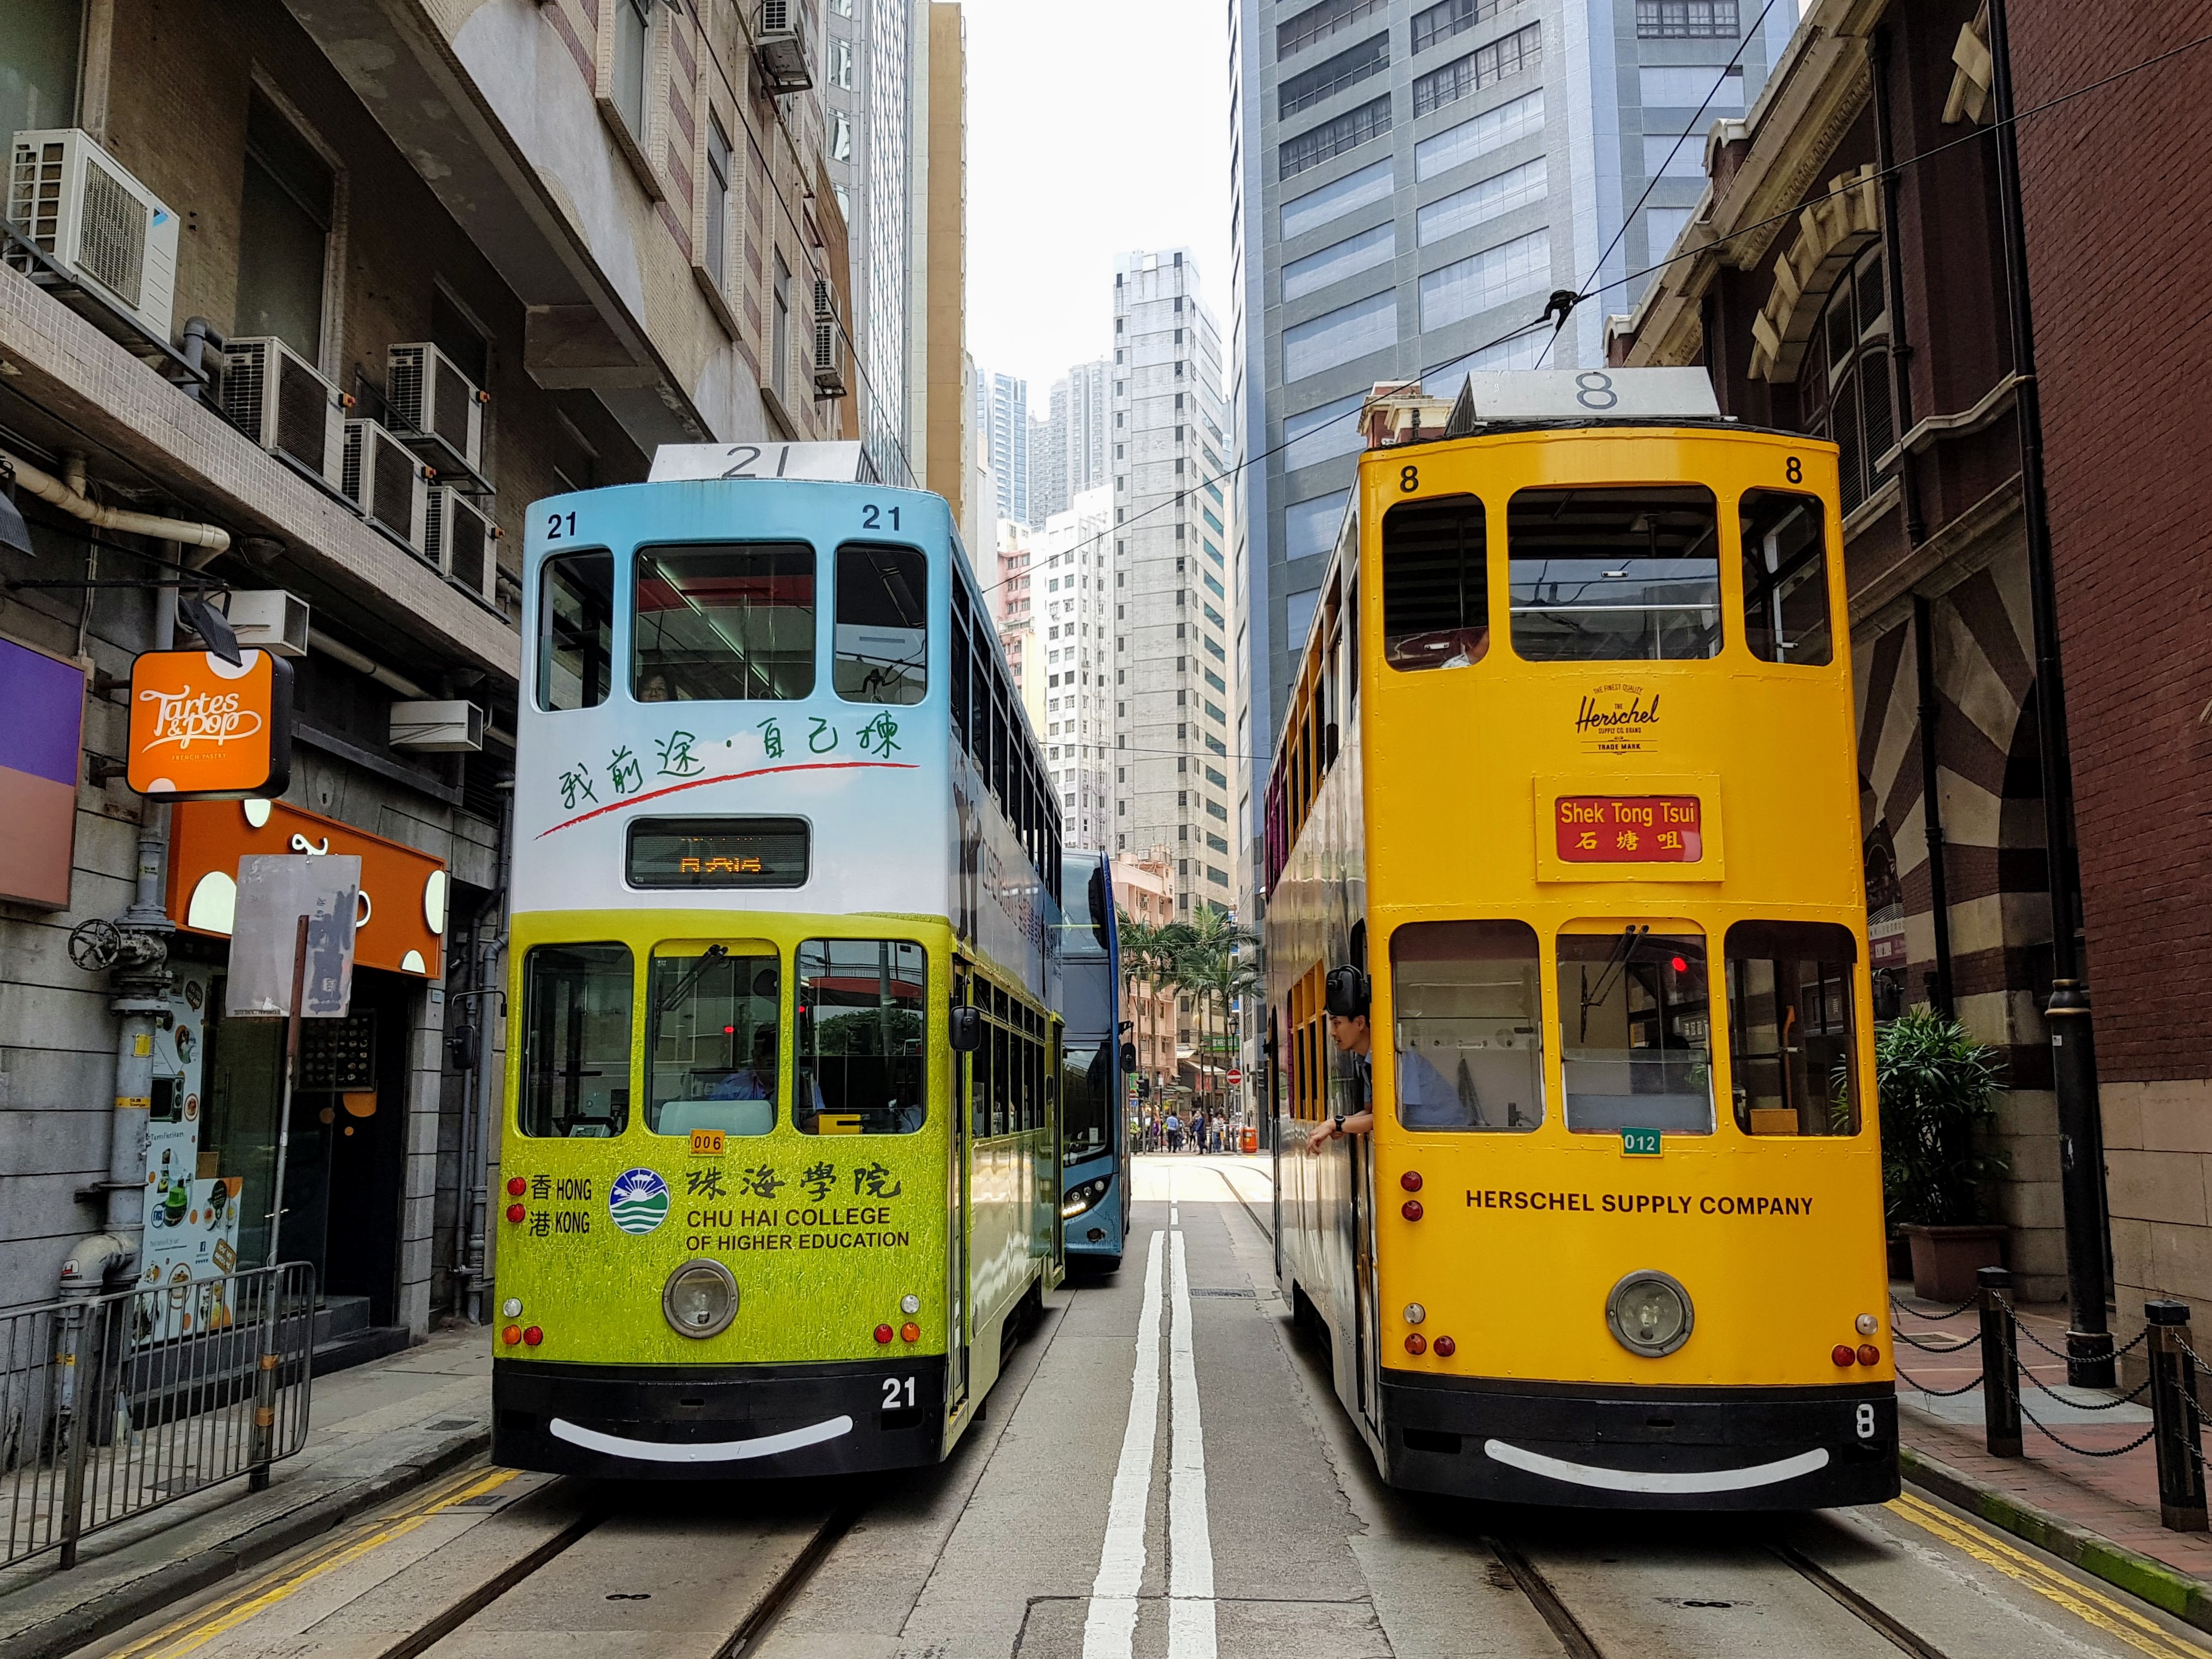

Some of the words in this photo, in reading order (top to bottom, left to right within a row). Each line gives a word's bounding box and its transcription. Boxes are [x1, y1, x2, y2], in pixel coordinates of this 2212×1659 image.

[1575, 372, 1618, 409] 8
[721, 445, 790, 478] 21
[1786, 456, 1803, 484] 8
[1400, 465, 1419, 493] 8
[547, 511, 576, 540] 21
[862, 504, 900, 531] 21
[1593, 686, 1604, 694] THE
[1604, 683, 1621, 692] FINEST
[1623, 683, 1643, 696] QUALITY
[139, 685, 239, 737] Tartes
[1575, 694, 1660, 734] Herschel
[167, 718, 183, 737] &
[1561, 802, 1604, 823] Shek
[1611, 802, 1652, 827] Tong
[1660, 802, 1694, 823] Tsui
[1574, 830, 1682, 852] 石塘咀
[694, 1136, 721, 1150] 006
[1624, 1134, 1655, 1151] 012
[556, 1178, 592, 1201] HONG
[686, 1161, 901, 1202] 珠海學院
[1466, 1190, 1594, 1211] HERSCHEL
[1602, 1194, 1692, 1214] SUPPLY
[1699, 1196, 1813, 1215] COMPANY
[555, 1211, 590, 1234] KONG
[687, 1210, 733, 1228] CHU
[741, 1209, 778, 1227] HAI
[785, 1207, 890, 1226] COLLEGE
[686, 1235, 712, 1251] OF
[718, 1234, 792, 1251] HIGHER
[798, 1231, 909, 1249] EDUCATION
[882, 1377, 915, 1409] 21
[1856, 1404, 1874, 1438] 8
